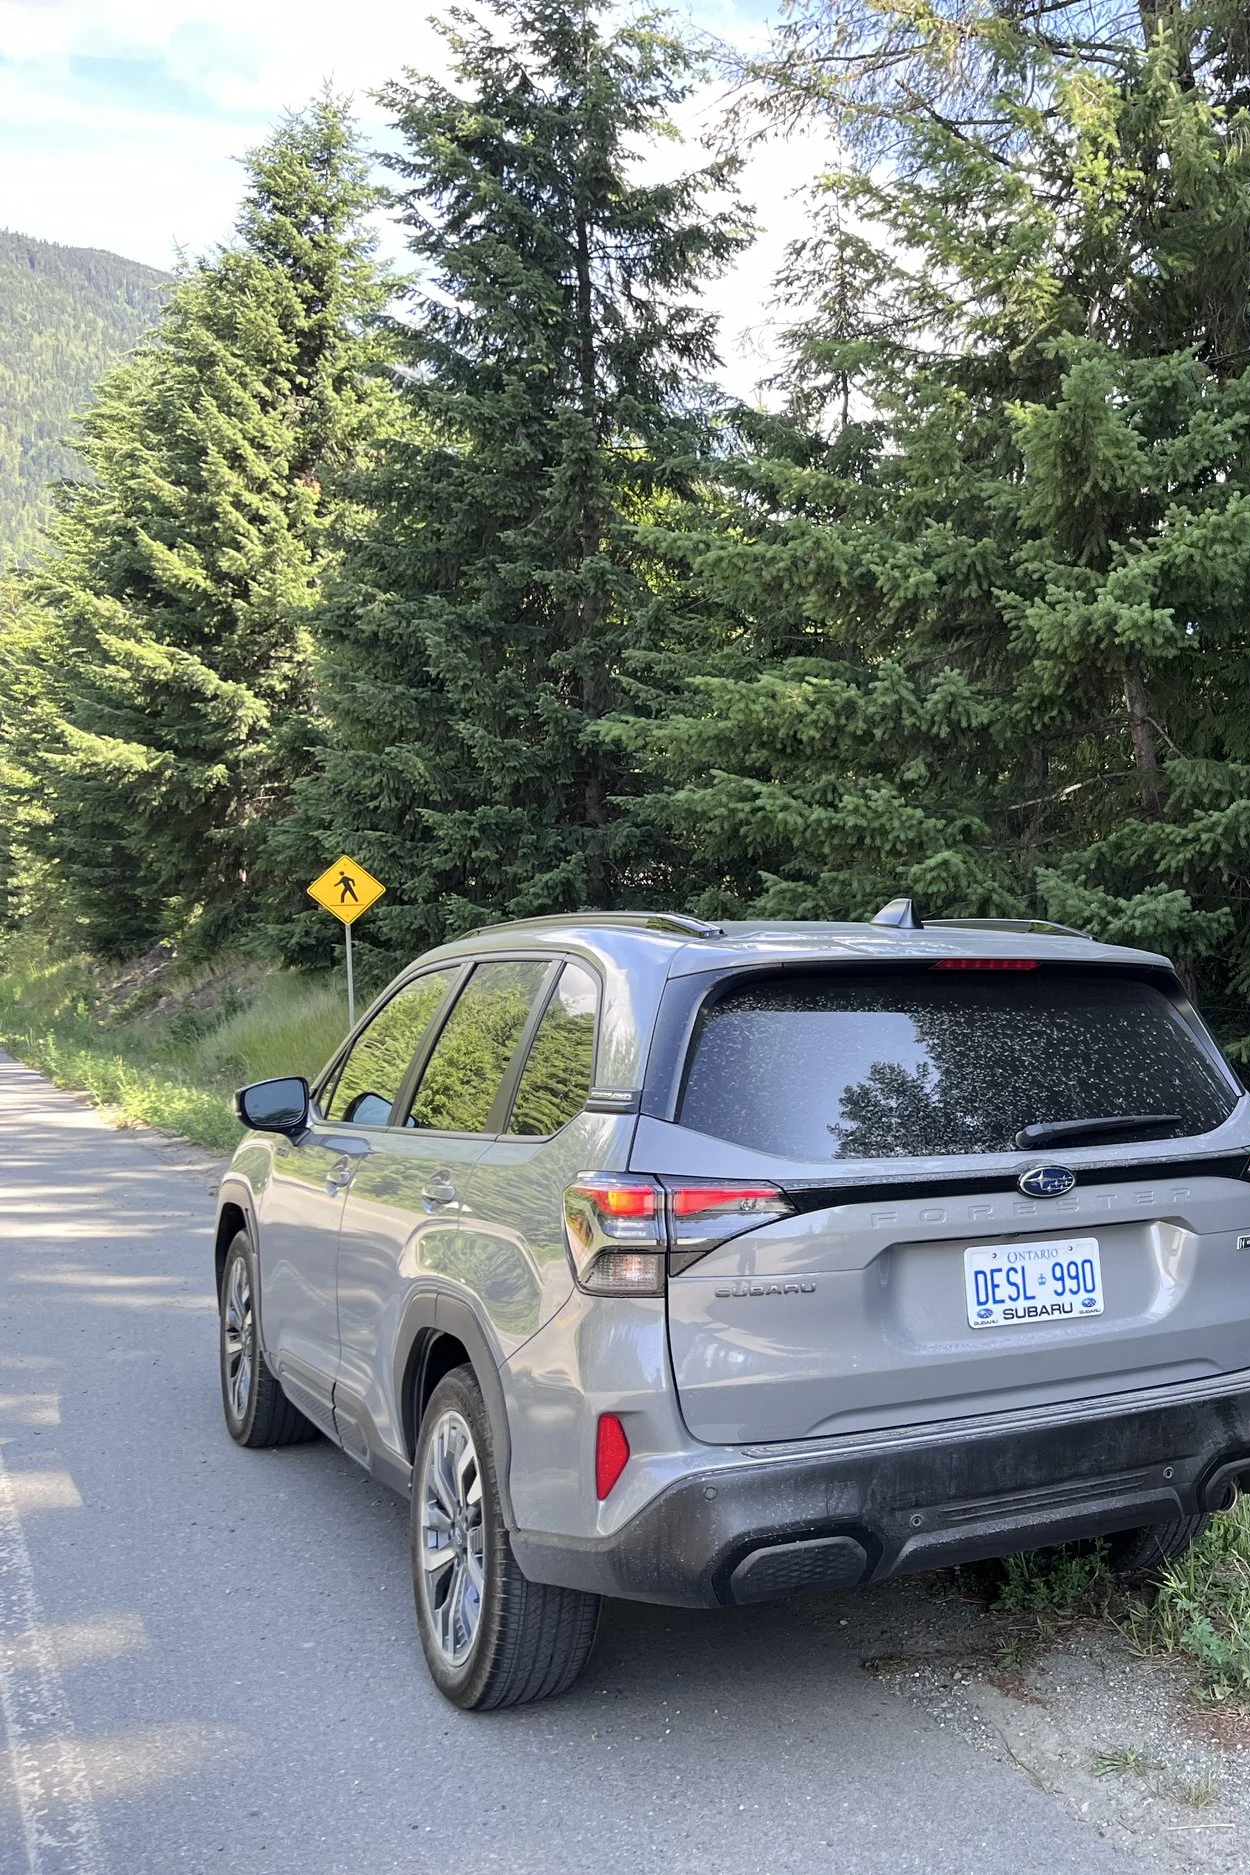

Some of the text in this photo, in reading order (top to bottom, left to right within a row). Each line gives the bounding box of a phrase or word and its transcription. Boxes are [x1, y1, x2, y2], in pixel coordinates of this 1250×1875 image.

[871, 1187, 1191, 1228] FORESTER
[714, 1283, 816, 1298] SUBARU
[974, 1258, 1096, 1306] DESL 990
[1002, 1302, 1073, 1321] SUBARU
